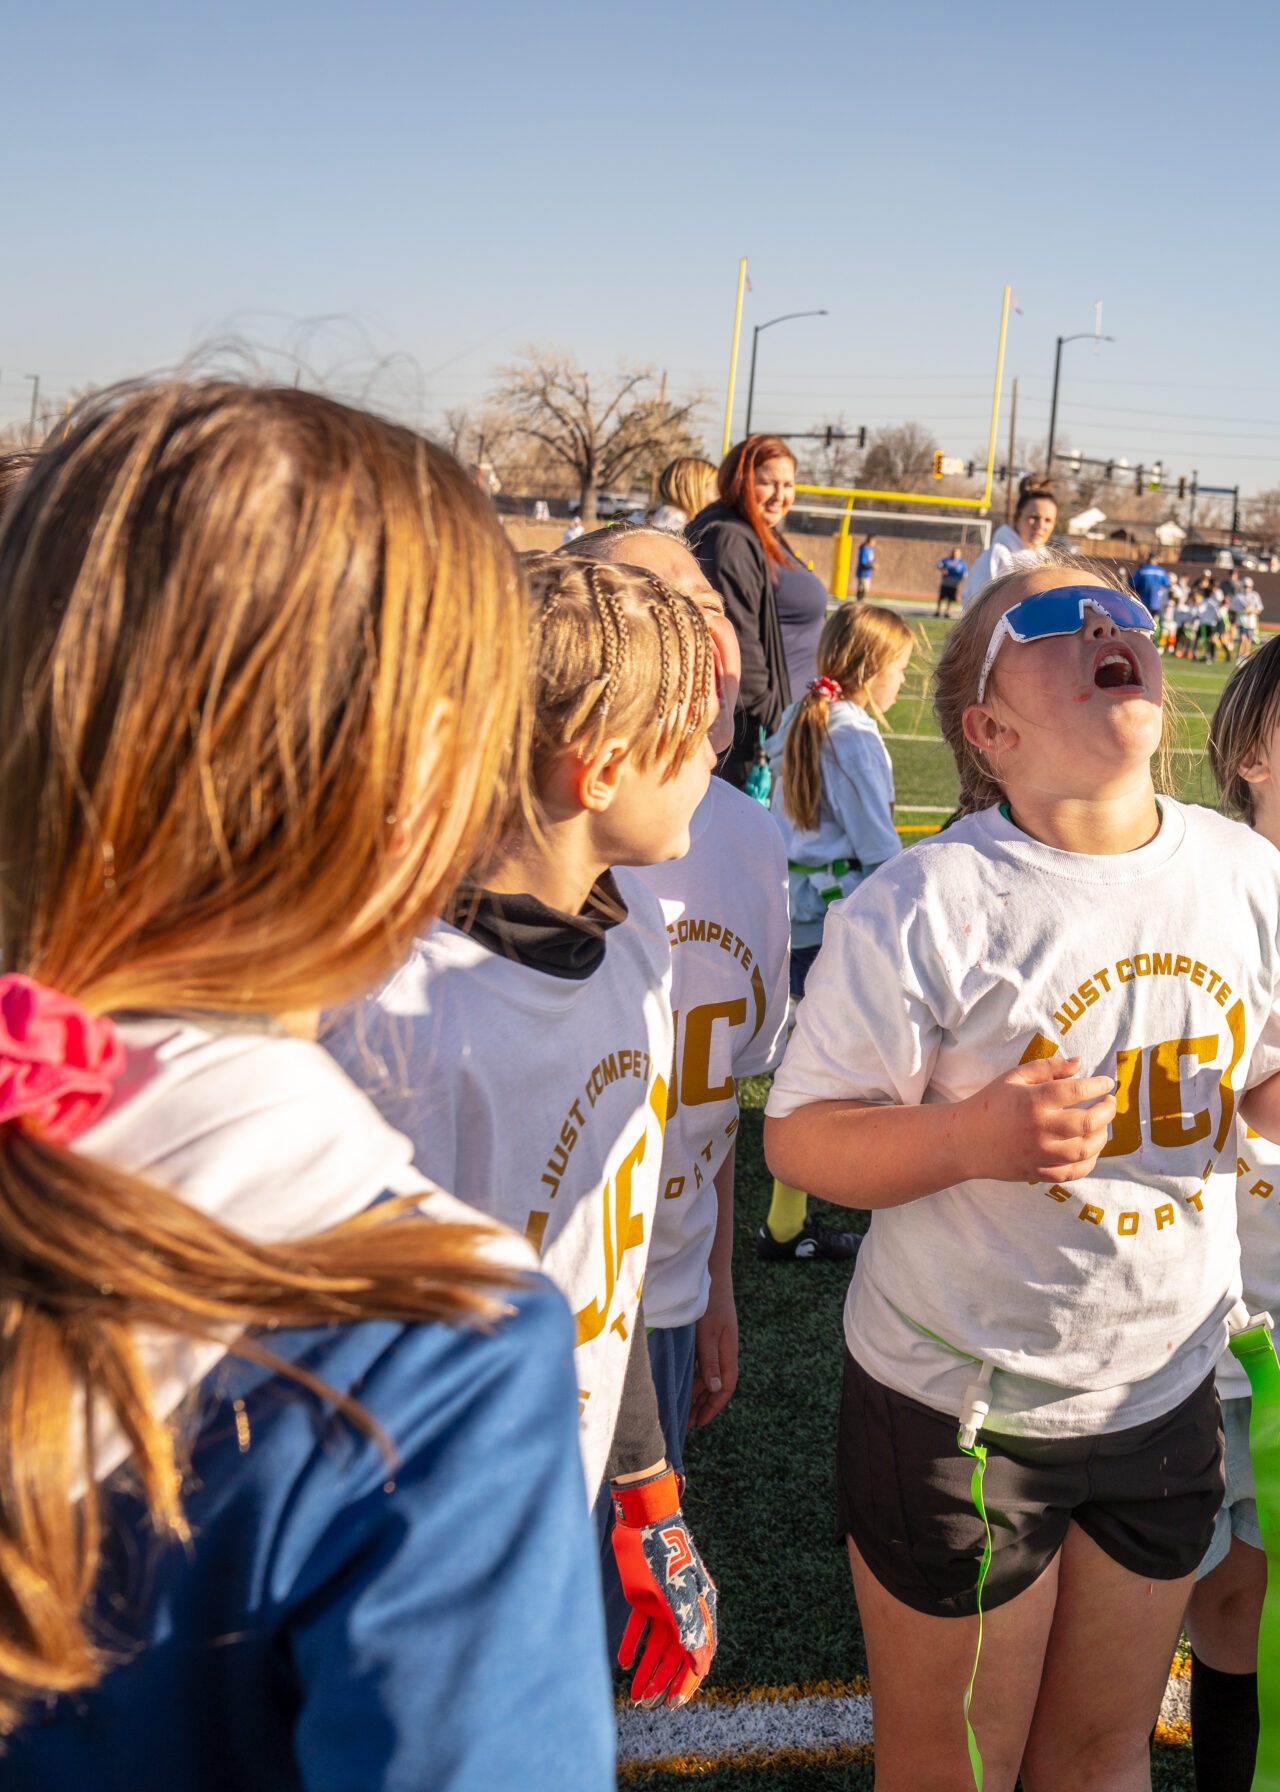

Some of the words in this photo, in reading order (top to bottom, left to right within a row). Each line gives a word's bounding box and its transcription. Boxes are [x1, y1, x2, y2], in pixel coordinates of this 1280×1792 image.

[1054, 968, 1113, 1035] JUST
[1116, 952, 1232, 1006] COMPETE
[541, 1097, 585, 1199] JUST
[585, 1049, 652, 1109] COMPET
[664, 1115, 739, 1200] ORTS
